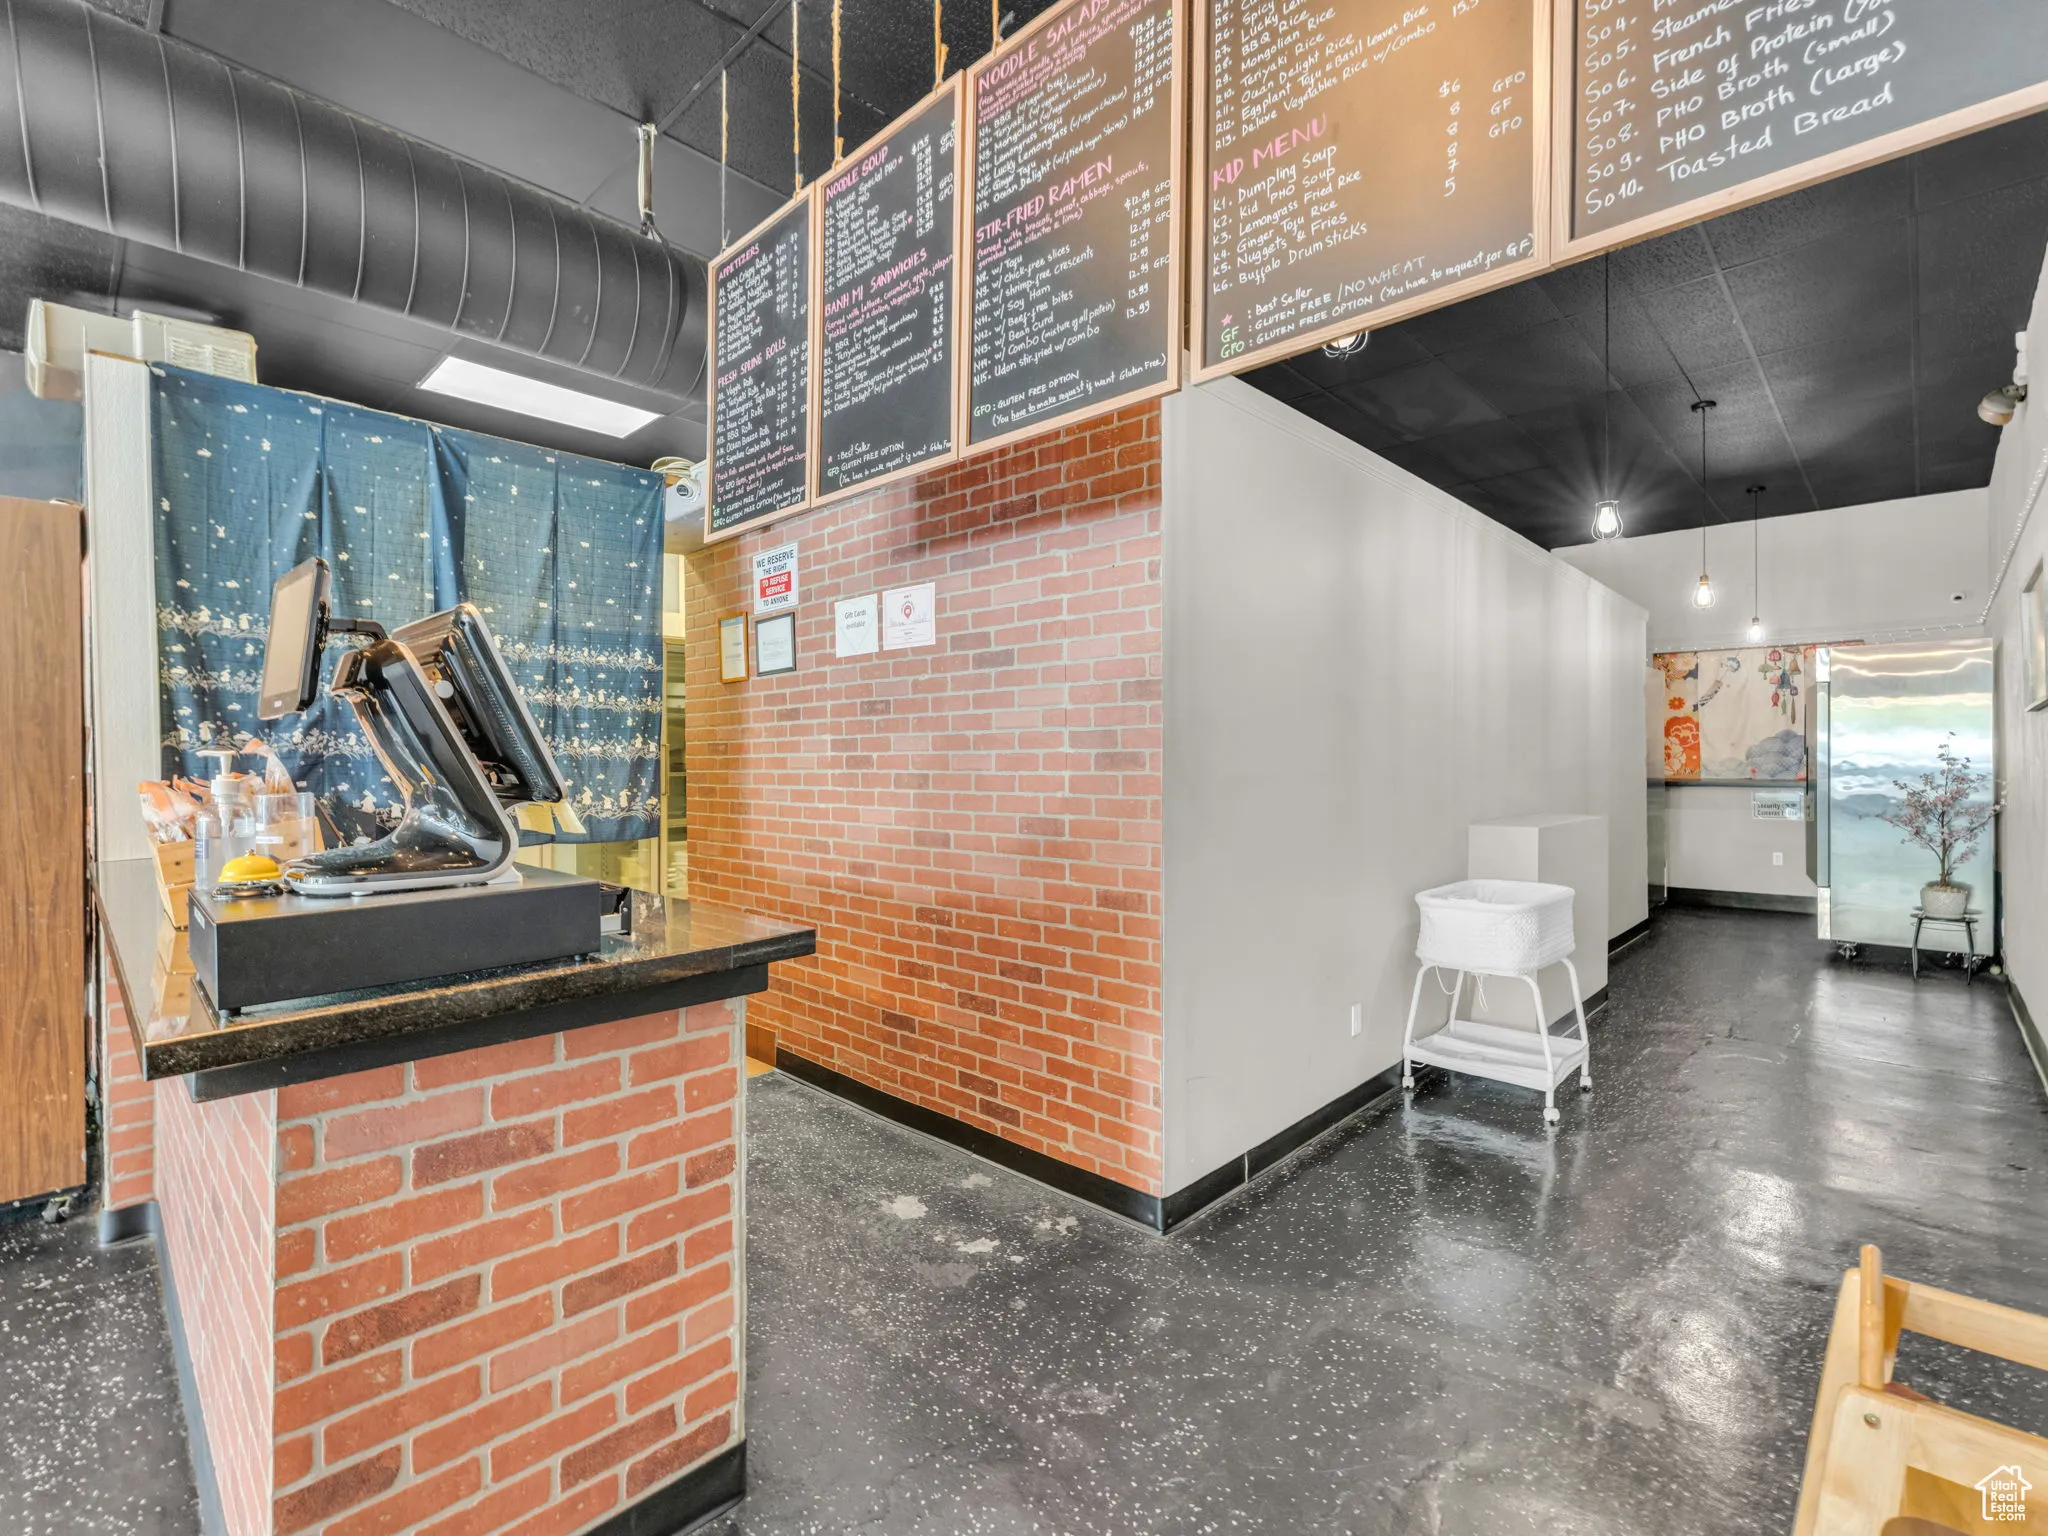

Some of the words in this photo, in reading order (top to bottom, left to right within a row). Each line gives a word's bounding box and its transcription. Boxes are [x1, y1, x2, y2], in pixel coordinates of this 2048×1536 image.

[977, 39, 1039, 94] NOODLE
[1241, 30, 1300, 72] Mongolian
[1307, 8, 1336, 31] Rice
[1241, 81, 1292, 120] Eggplant
[1335, 39, 1363, 67] Basil
[1403, 5, 1429, 28] Rice
[1242, 32, 1271, 56] BBQ
[1279, 10, 1310, 33] Rice
[1279, 52, 1320, 84] Delight
[1325, 33, 1355, 56] Rice
[1295, 33, 1325, 56] Rice
[1650, 68, 1706, 99] Side
[1716, 53, 1741, 81] of
[1750, 14, 1834, 60] Protein
[1653, 25, 1732, 73] French
[1241, 110, 1277, 137] Deluxe
[1283, 76, 1338, 112] Vegetables
[1343, 59, 1368, 81] Rice
[1656, 96, 1704, 128] PHO
[1717, 57, 1789, 100] Broth
[1803, 10, 1896, 65] (small)
[1212, 158, 1244, 192] KID
[1253, 111, 1327, 169] MENU
[1238, 164, 1297, 204] Dumpling
[1302, 145, 1337, 169] Soup
[1439, 78, 1461, 97] $6
[1492, 71, 1526, 92] GFO
[1656, 125, 1773, 182] Toasted
[1794, 81, 1894, 135] Bread
[1659, 124, 1706, 154] PHO
[1721, 85, 1796, 130] Broth
[826, 166, 860, 201] NOODLE
[861, 145, 888, 177] SOUP
[1239, 201, 1259, 219] Kid
[1270, 184, 1295, 204] PHO
[1302, 167, 1336, 188] Soup
[1490, 96, 1512, 115] GF
[1239, 200, 1299, 236] Lemongrass
[1304, 183, 1333, 204] Fried
[1337, 170, 1362, 189] Rice
[1489, 116, 1523, 138] GFO
[976, 195, 1045, 244] STIR-FRIED
[1049, 154, 1113, 206] RAMEN
[1237, 228, 1275, 253] Ginger
[1280, 216, 1305, 236] Tofu
[1310, 200, 1338, 217] Rice
[1238, 257, 1281, 285] Buffalo
[1444, 176, 1456, 197] 5
[1237, 236, 1288, 268] Nuggets
[1310, 212, 1348, 236] Fries
[825, 293, 850, 317] BANH
[852, 285, 864, 304] MI
[870, 247, 927, 293] SANDWICHES
[1220, 326, 1240, 343] GF
[1255, 308, 1295, 330] GLUTEN
[1300, 292, 1332, 314] FREE
[1368, 255, 1426, 285] WHEAT
[1220, 341, 1245, 359] GFO
[1256, 323, 1295, 345] GLUTEN
[1299, 310, 1329, 327] FREE
[1332, 295, 1374, 317] OPTION
[1405, 275, 1429, 291] have
[1430, 267, 1442, 280] to
[1445, 250, 1485, 277] request
[1484, 250, 1502, 270] for
[1255, 296, 1278, 315] Best
[1281, 287, 1313, 306] Seller
[1028, 383, 1048, 398] FREE
[1049, 371, 1080, 388] OPTION
[756, 558, 766, 568] WE
[767, 549, 794, 566] RESERVE
[772, 563, 787, 574] RIGHT
[770, 594, 789, 605] ANYONE
